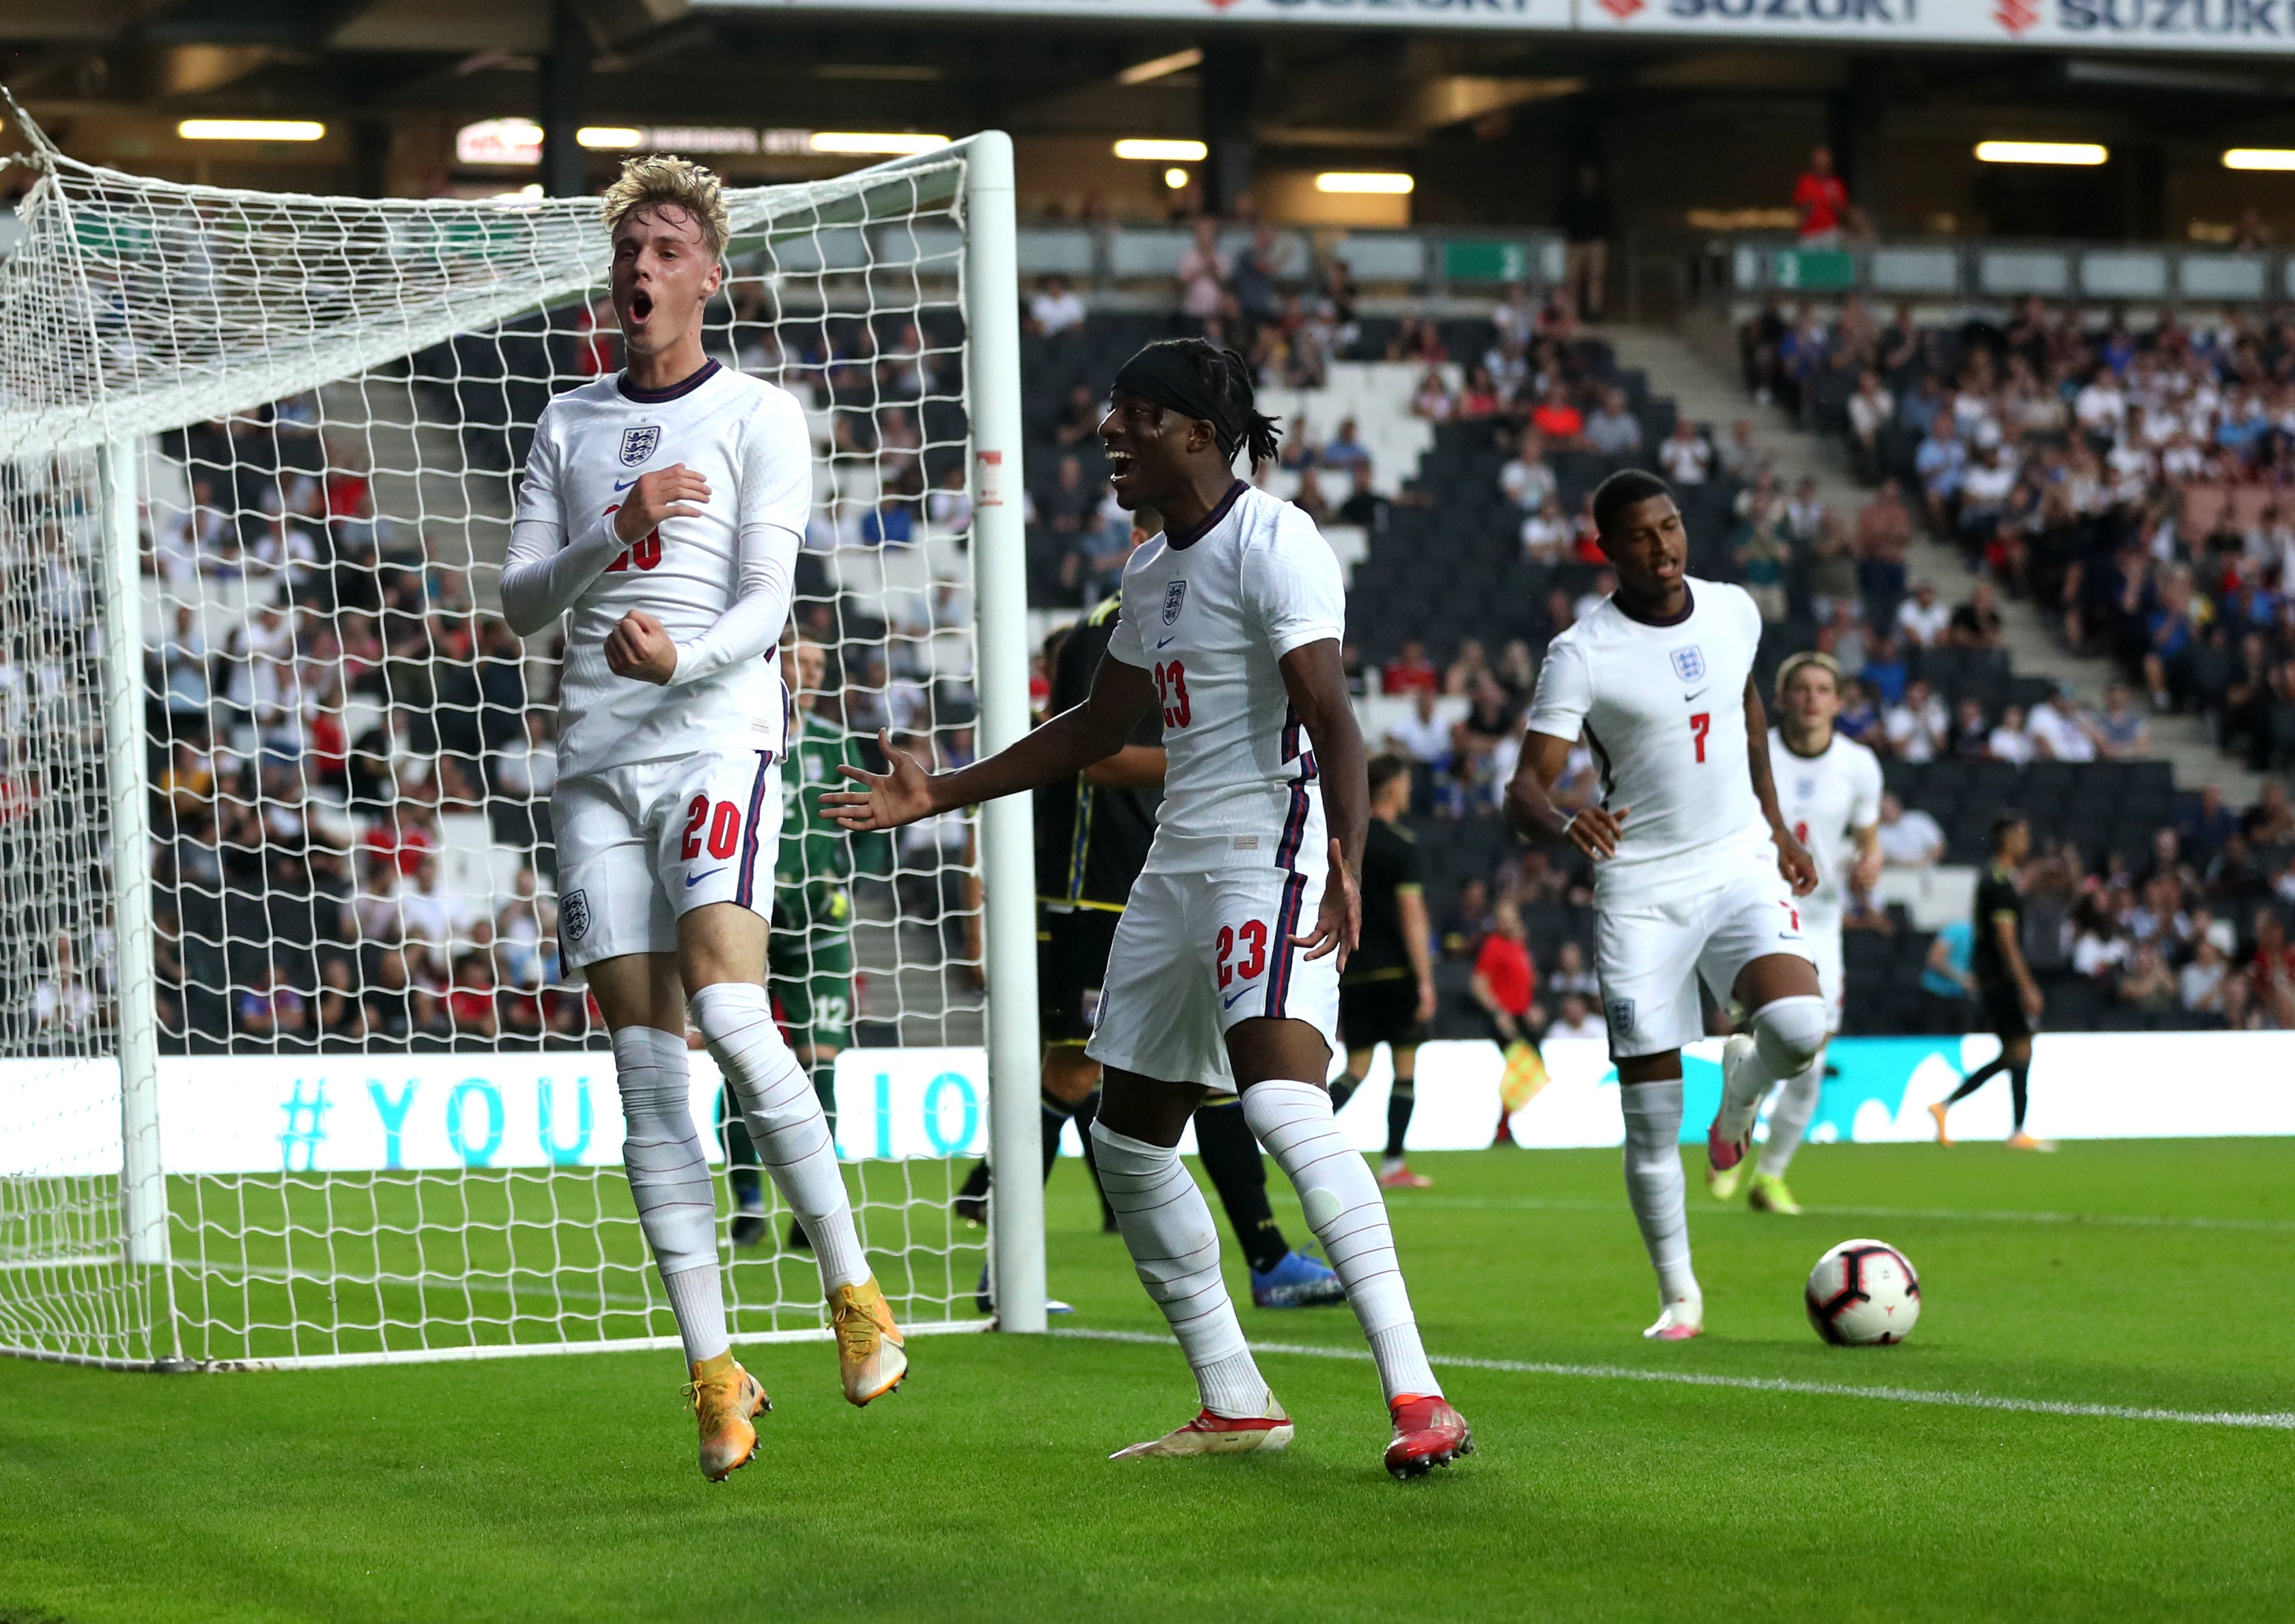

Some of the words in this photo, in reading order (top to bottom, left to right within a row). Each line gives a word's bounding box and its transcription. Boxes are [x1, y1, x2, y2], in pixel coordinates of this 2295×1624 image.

[1155, 659, 1191, 728] 23
[1690, 712, 1710, 763] 7
[681, 794, 741, 861] 20
[1216, 919, 1268, 992] 23
[815, 995, 848, 1034] 12
